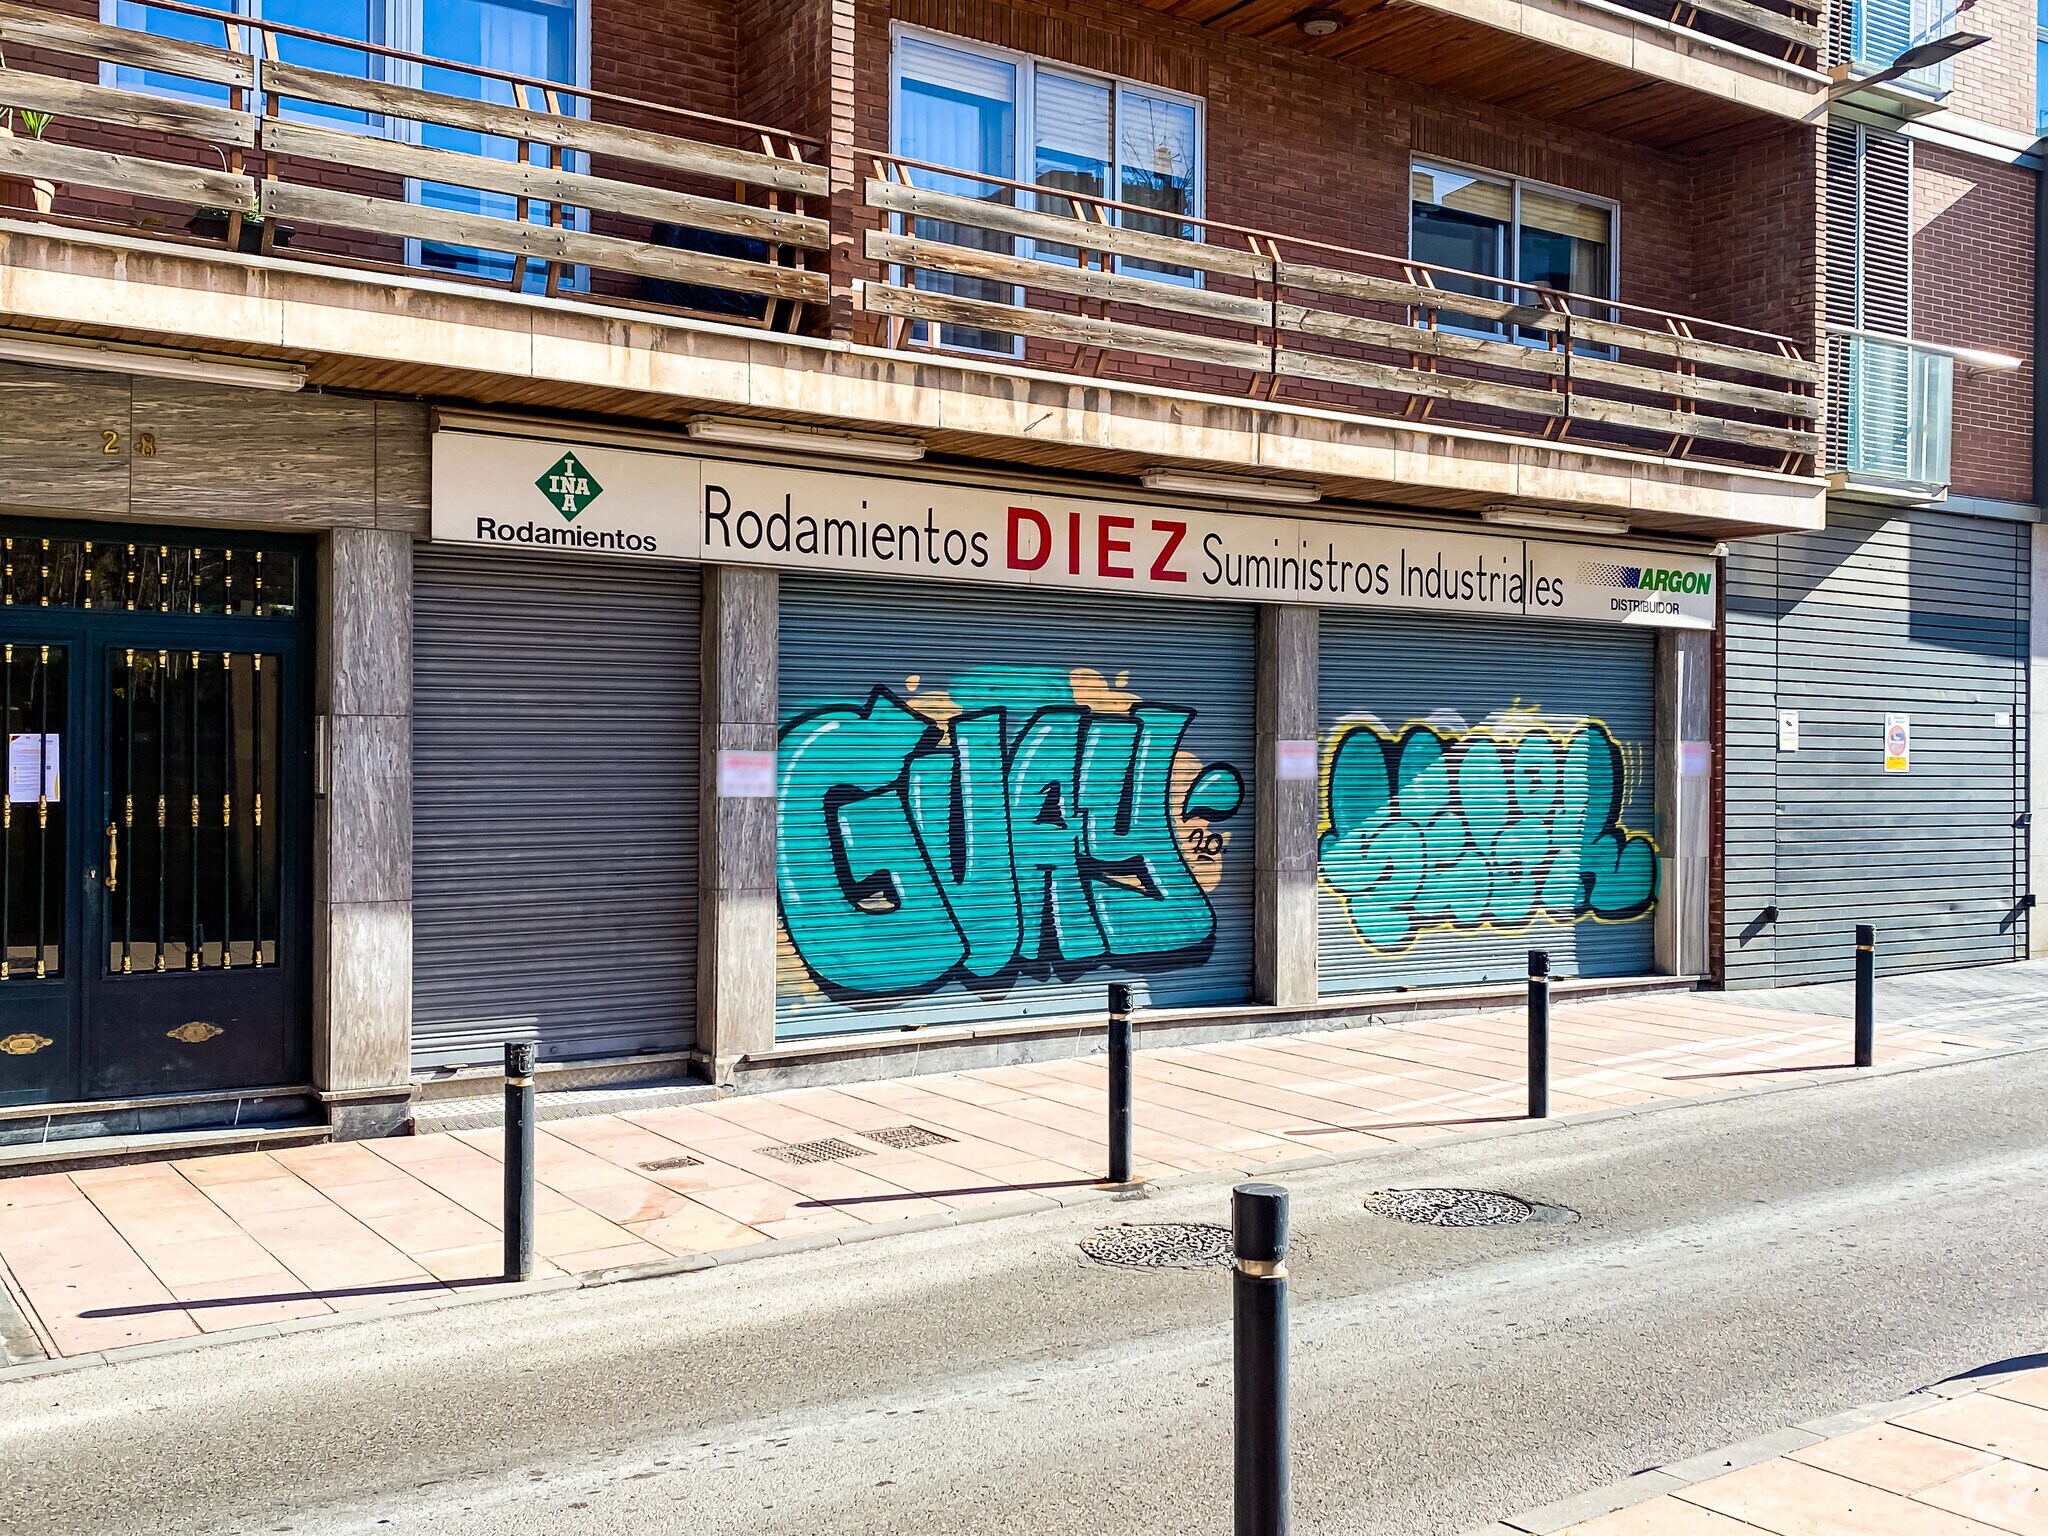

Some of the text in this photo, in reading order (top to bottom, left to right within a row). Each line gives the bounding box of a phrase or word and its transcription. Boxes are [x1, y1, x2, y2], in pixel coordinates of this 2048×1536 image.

[549, 475, 591, 495] INA
[478, 517, 657, 552] Rodamientos
[704, 485, 1564, 613] Rodamientos DIEZ Suministros Industriales
[1638, 568, 1712, 595] ARGON
[1610, 597, 1680, 615] DISTRIBUIDOR
